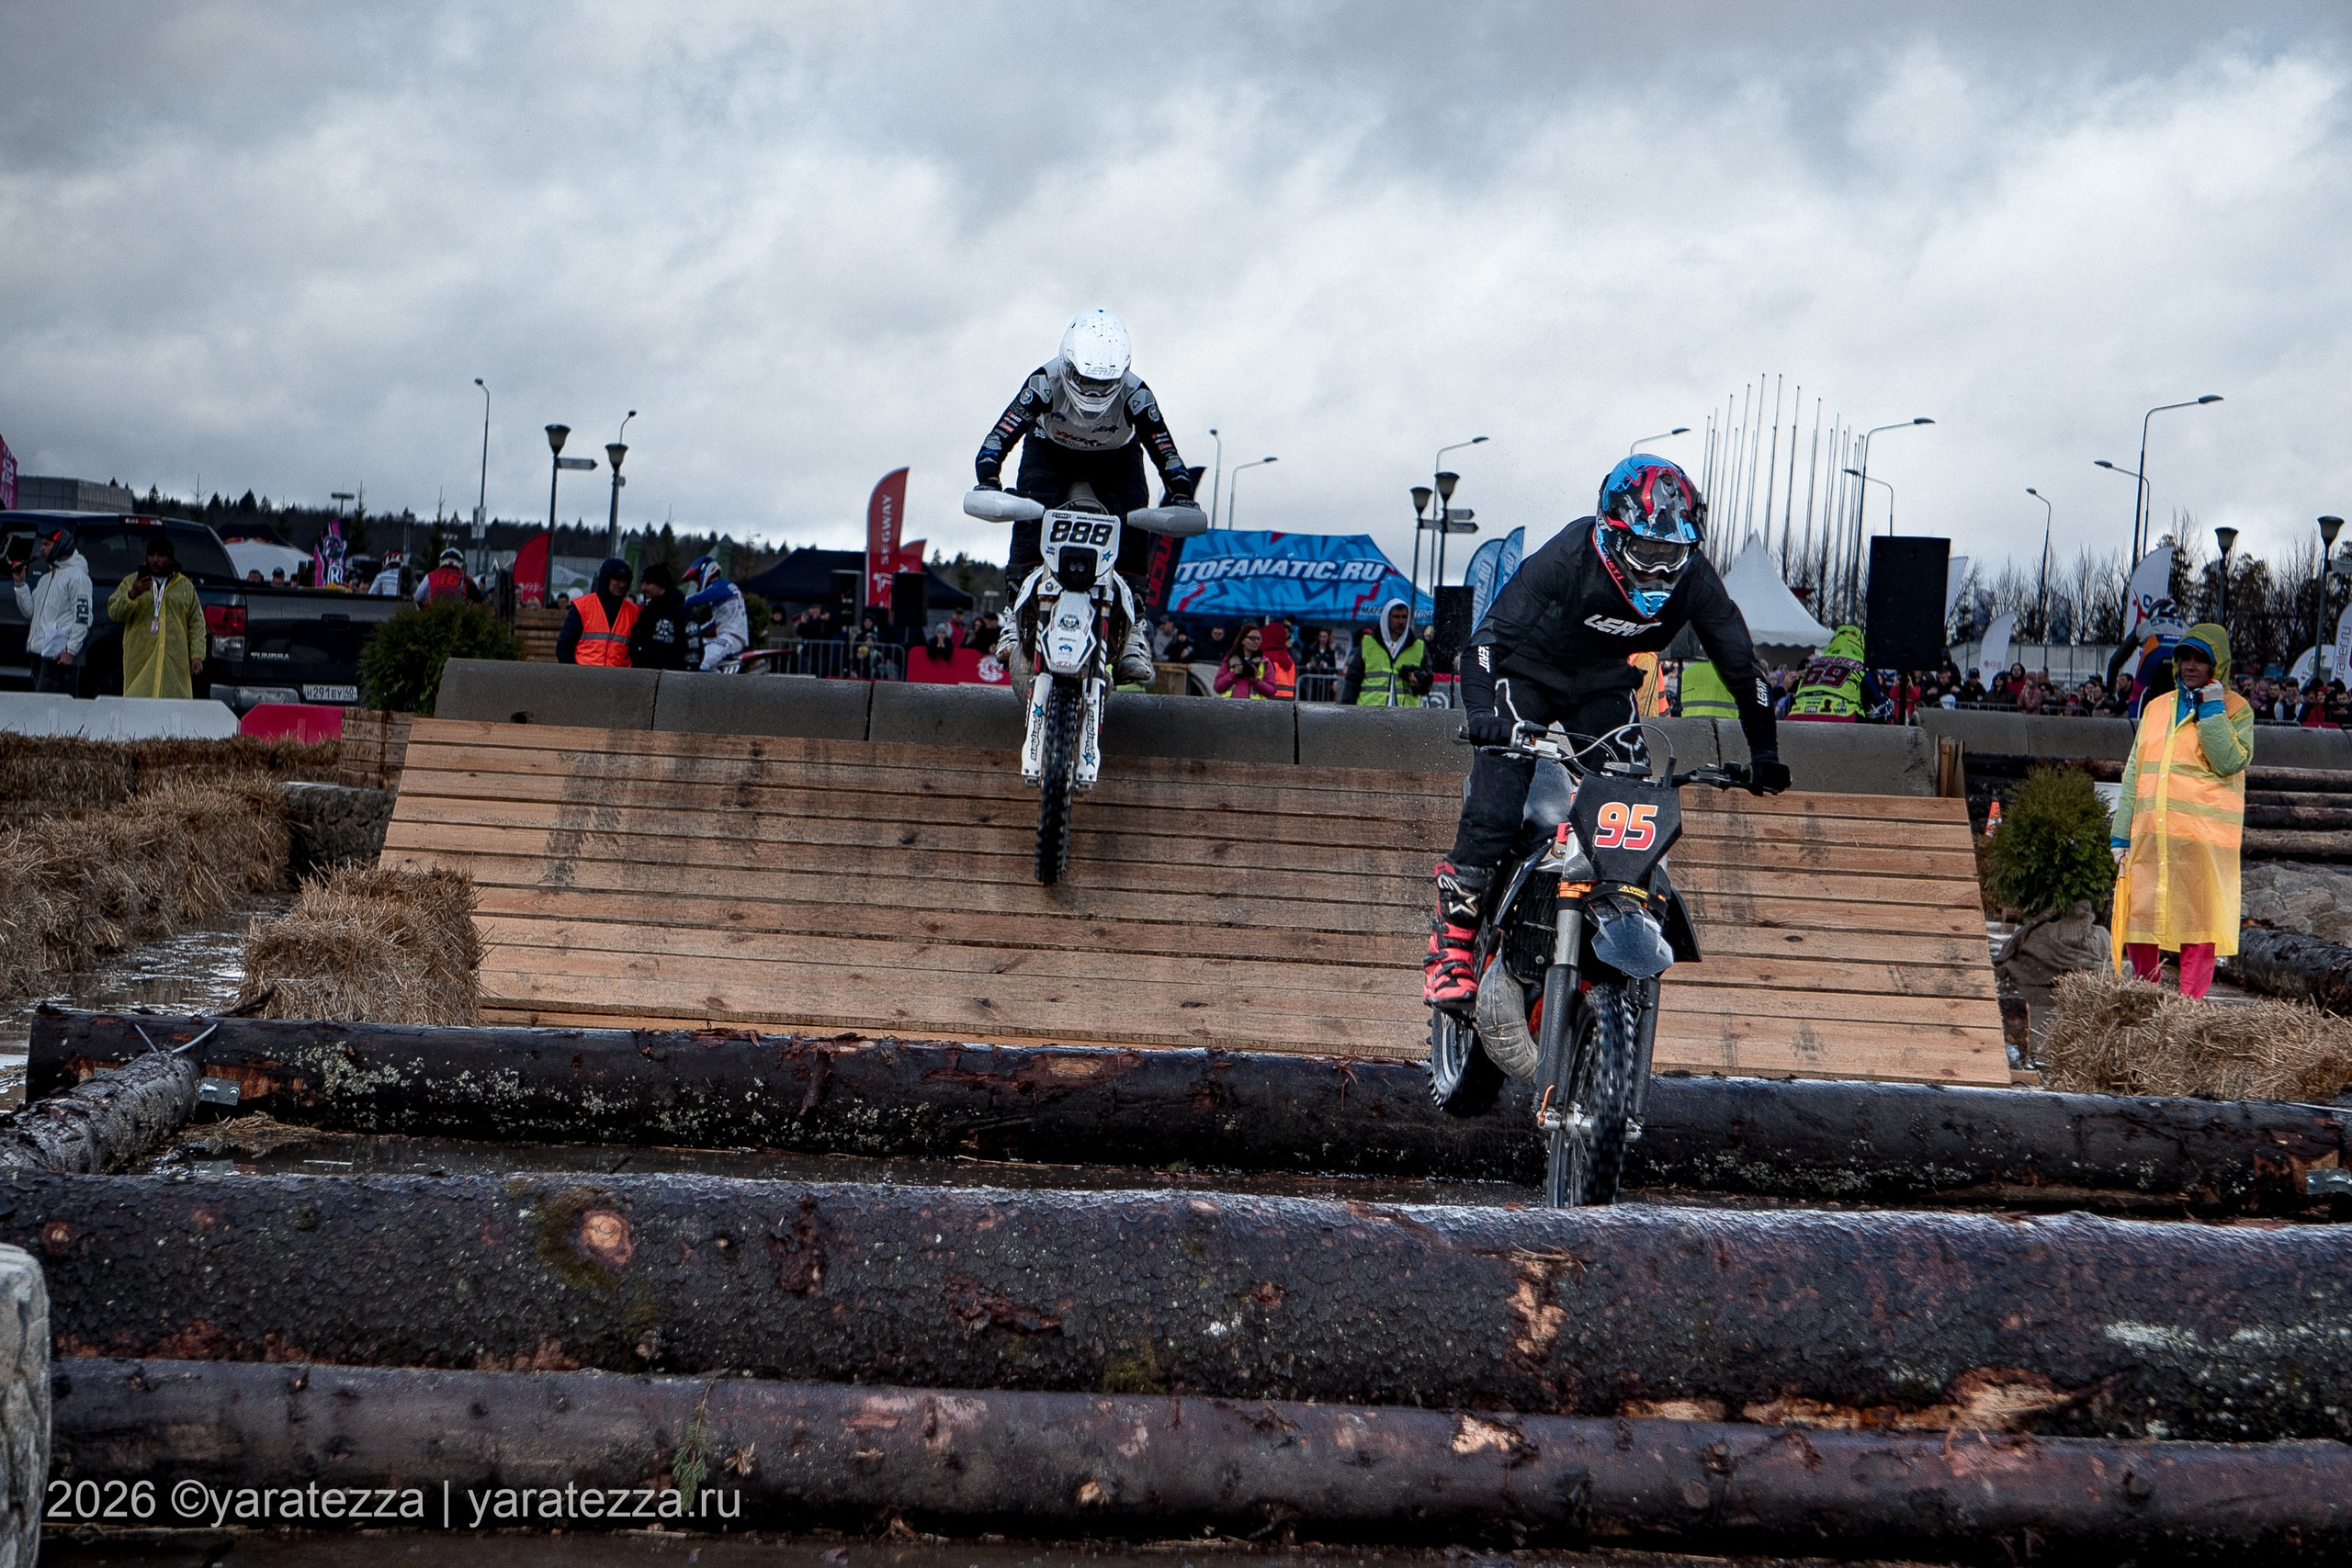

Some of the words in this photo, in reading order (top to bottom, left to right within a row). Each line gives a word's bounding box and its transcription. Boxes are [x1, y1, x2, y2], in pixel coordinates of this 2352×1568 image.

[1085, 367, 1120, 377] LEATT
[880, 493, 892, 566] SEGWAY
[1049, 519, 1114, 547] 888
[1174, 558, 1386, 583] TOFANATIC.RU
[1584, 614, 1662, 637] LEATT
[251, 651, 290, 660] TUNDRA
[1801, 663, 1852, 689] 69
[1756, 677, 1768, 707] LEATT
[1595, 801, 1659, 852] 95
